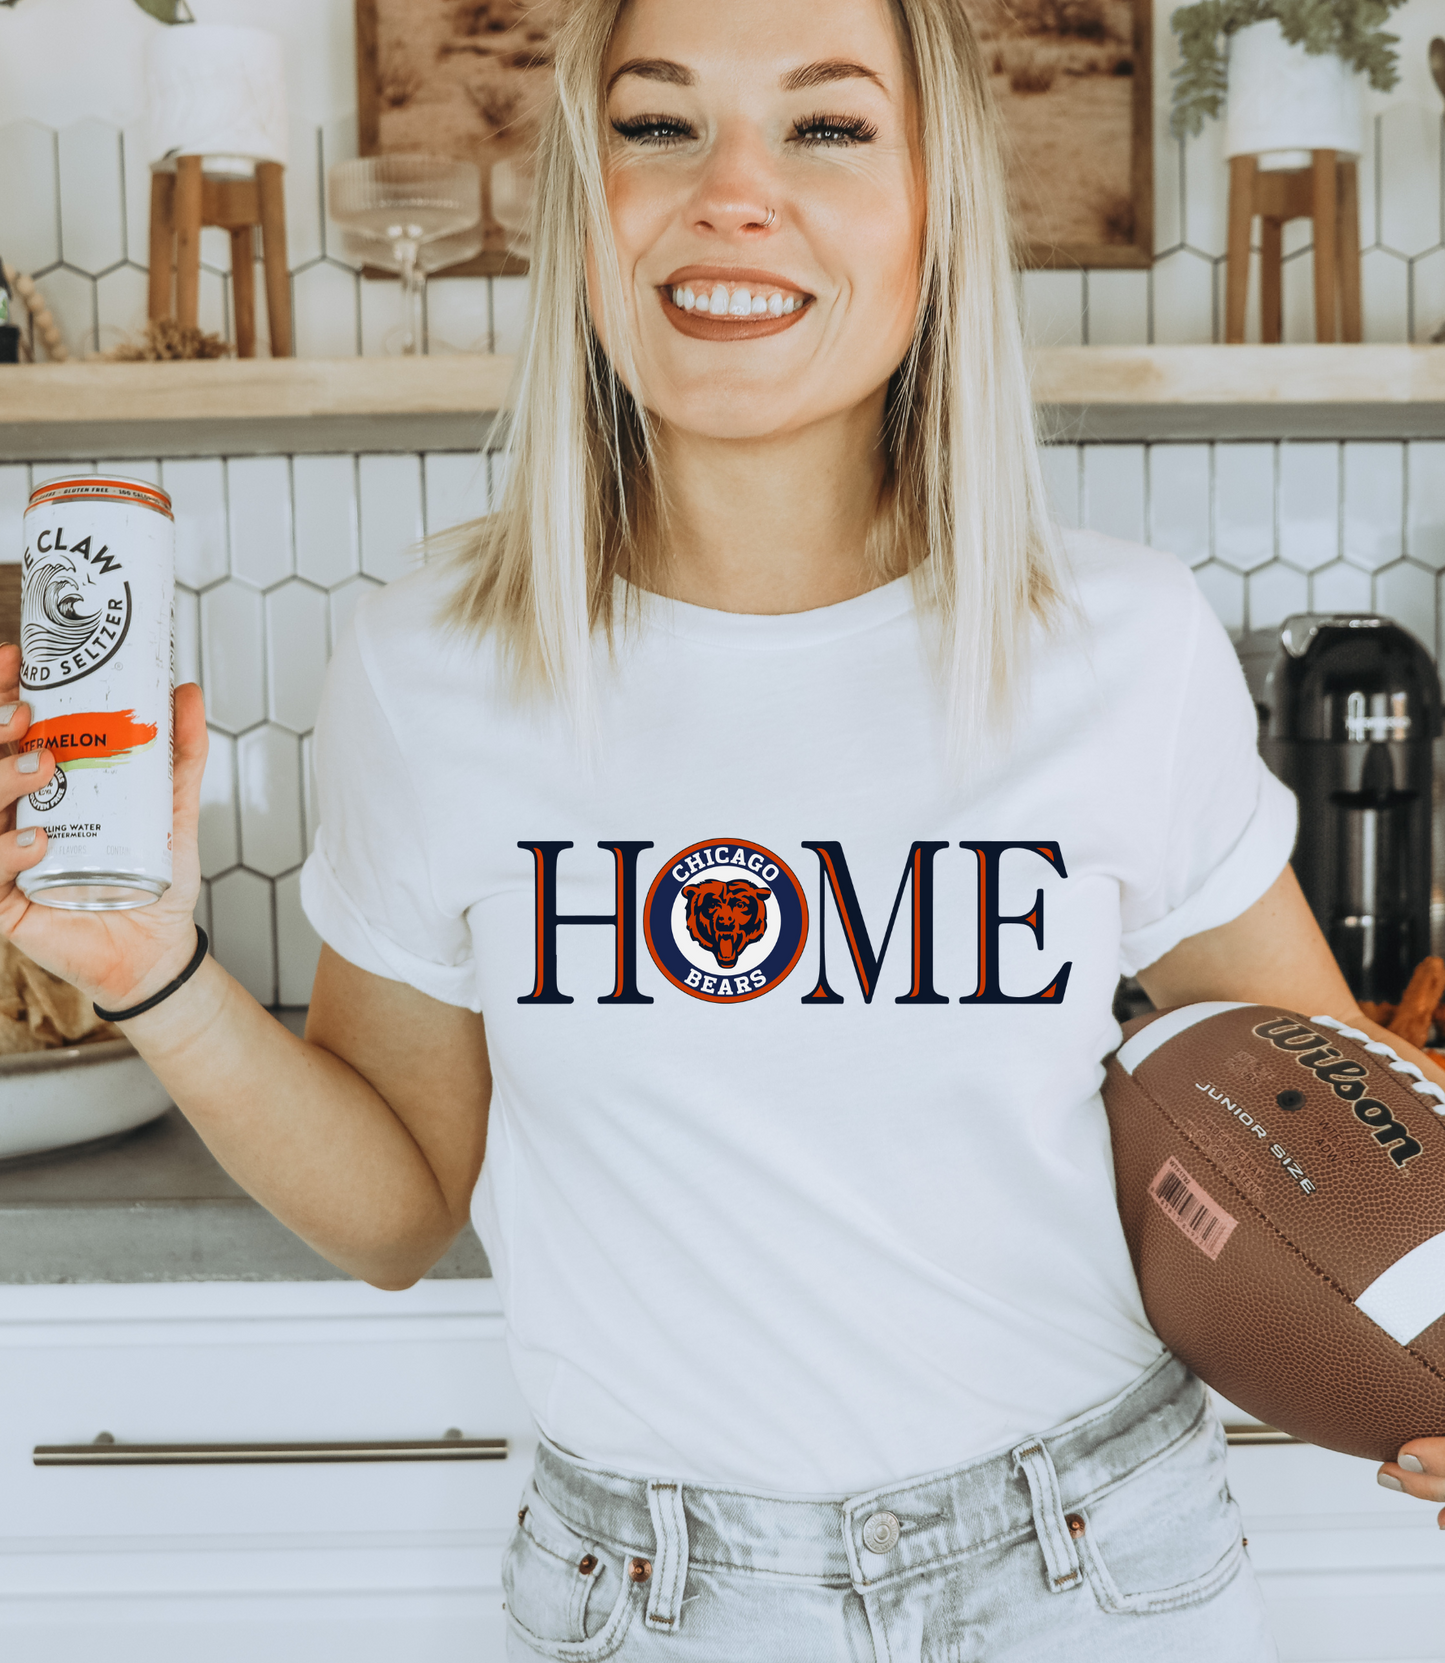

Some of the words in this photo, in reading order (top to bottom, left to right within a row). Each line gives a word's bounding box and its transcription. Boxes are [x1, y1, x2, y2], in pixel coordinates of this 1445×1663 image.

[37, 527, 122, 574] CLAW
[60, 599, 123, 675] SELTZER
[69, 823, 101, 831] WATER
[672, 847, 779, 882] CHICAGO
[684, 968, 767, 995] BEARS
[1252, 1016, 1423, 1169] Wilson
[1195, 1083, 1267, 1138] JUNIOR
[1270, 1143, 1316, 1194] SIZE
[1314, 1139, 1341, 1162] ADW
[1319, 1119, 1361, 1165] WTF1792
